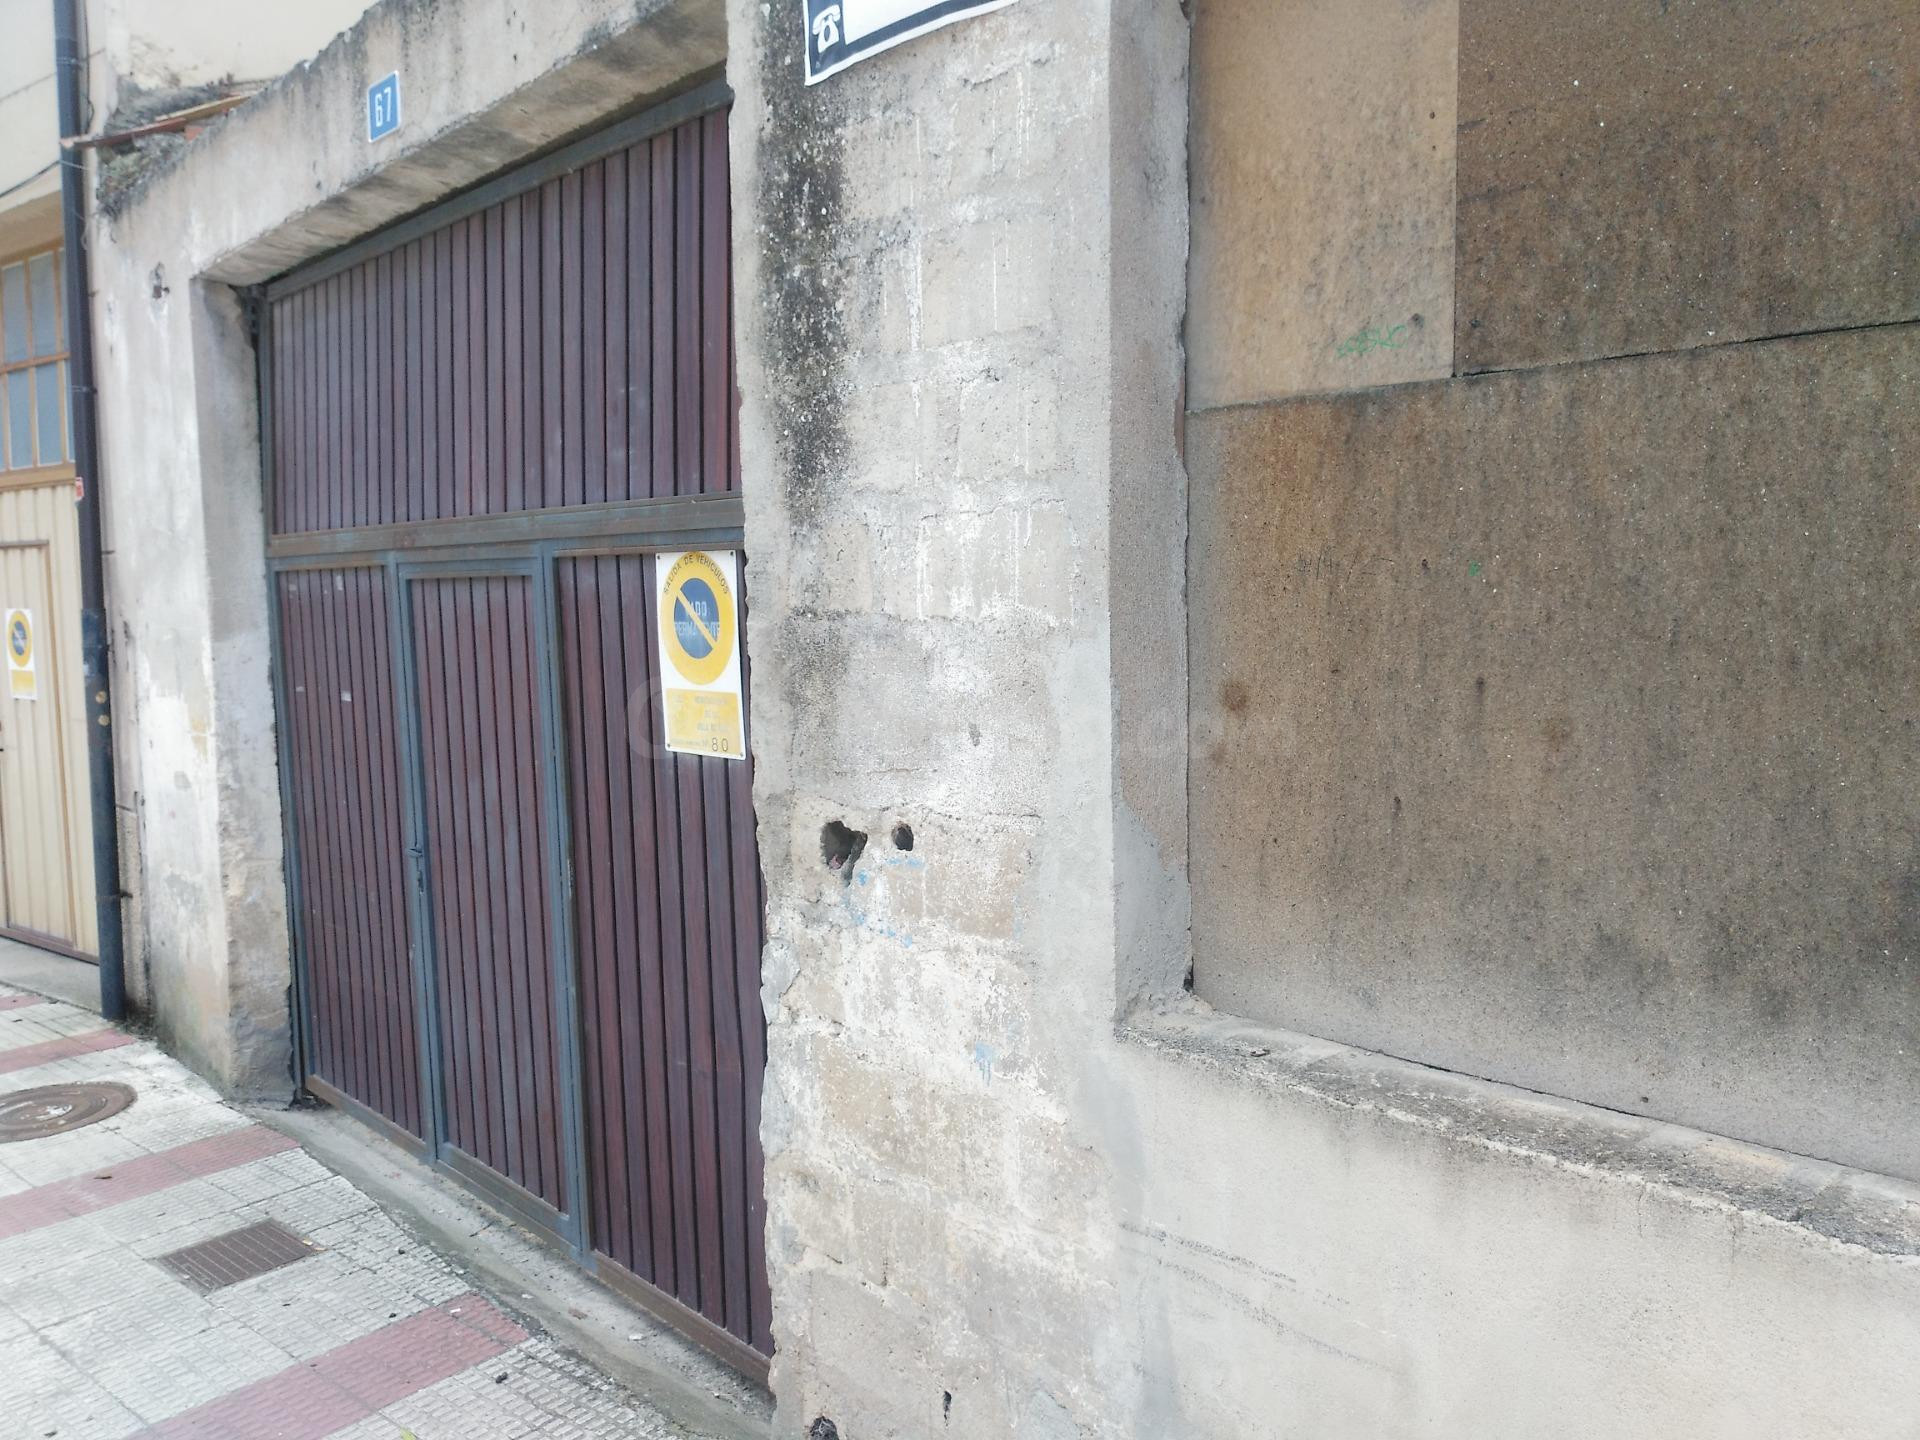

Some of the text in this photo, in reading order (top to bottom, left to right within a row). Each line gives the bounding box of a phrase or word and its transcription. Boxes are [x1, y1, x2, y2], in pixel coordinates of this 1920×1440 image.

[375, 87, 391, 127] 67
[663, 554, 730, 594] SALIDA DE VEHICULOS
[711, 737, 729, 752] 80
